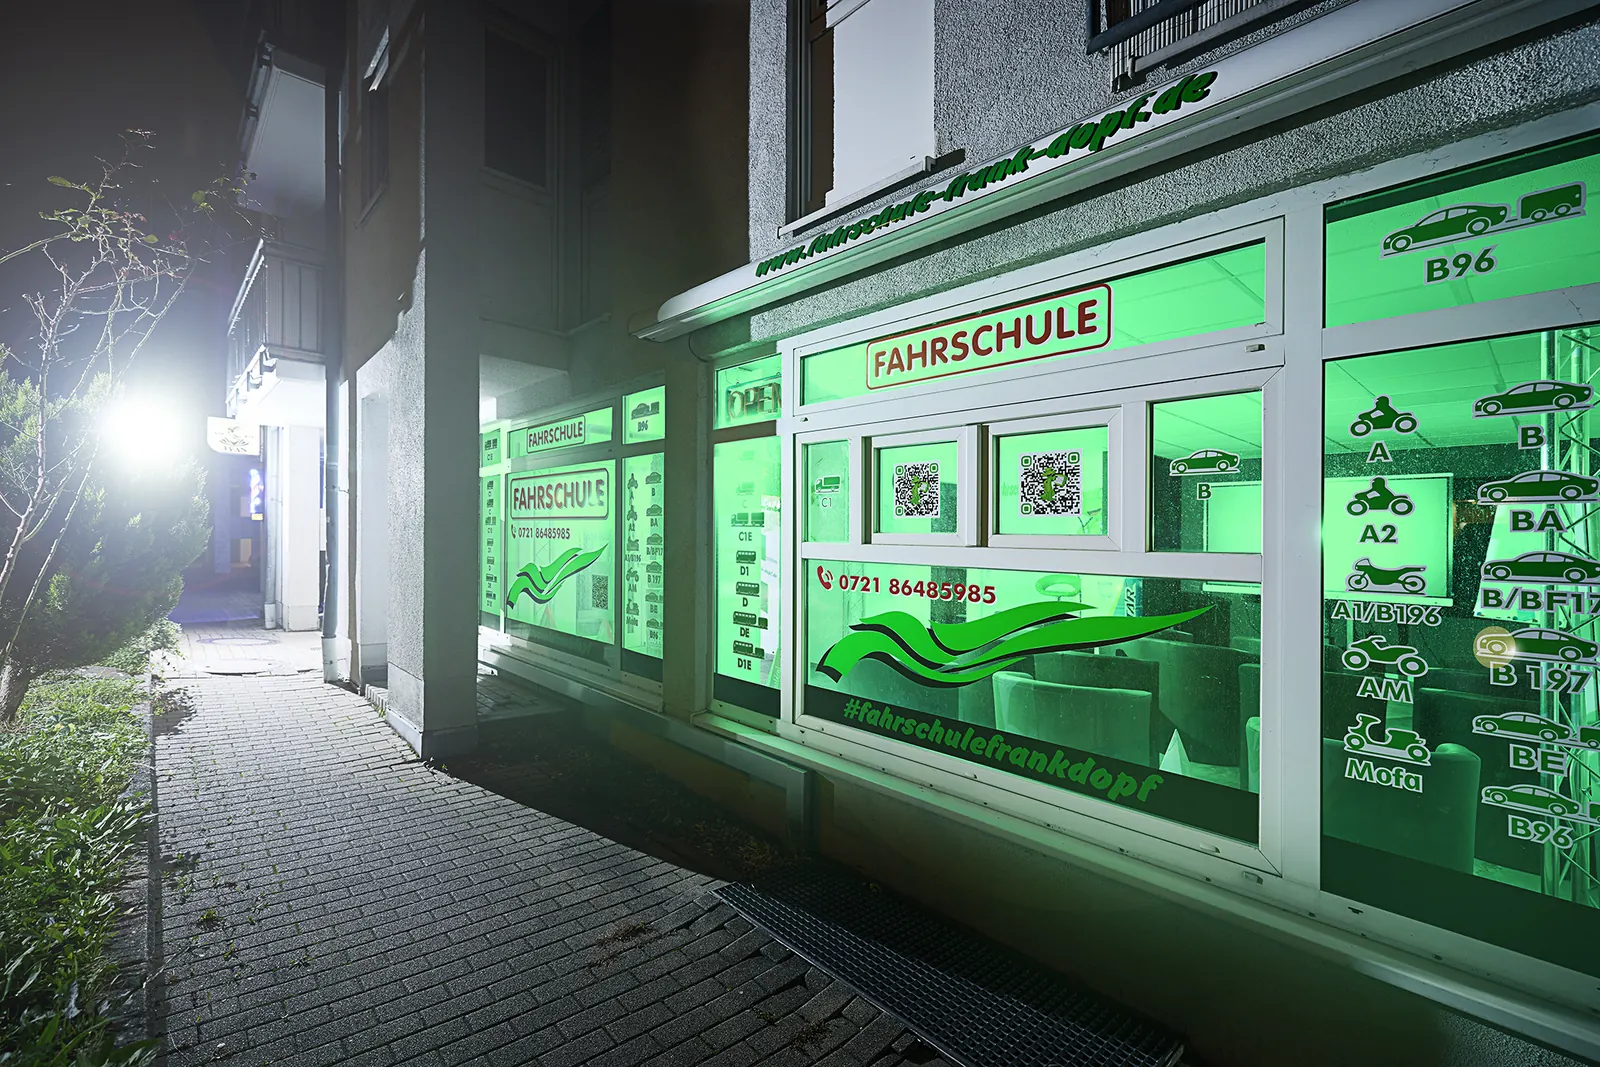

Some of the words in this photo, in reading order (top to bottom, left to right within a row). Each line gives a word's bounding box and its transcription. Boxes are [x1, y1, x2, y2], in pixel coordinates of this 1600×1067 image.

[755, 70, 1218, 278] www.fahrschule-frank-dopf.de
[1425, 246, 1498, 284] B96
[874, 299, 1099, 378] FAHRSCHULE
[528, 421, 583, 448] FAHRSCHULE
[1518, 425, 1546, 450] B
[1366, 441, 1392, 463] A
[513, 479, 605, 511] FAHRSCHULE
[821, 497, 832, 508] C1
[1197, 483, 1212, 500] B
[650, 517, 658, 527] BA
[1510, 508, 1568, 532] BA
[518, 527, 533, 538] 0721
[535, 527, 571, 540] 86485985
[738, 531, 752, 542] C1E
[1359, 524, 1398, 544] A2
[739, 565, 749, 576] D1
[839, 574, 881, 594] 0721
[889, 578, 997, 604] 86485985
[1483, 587, 1600, 614] B/BF17
[742, 597, 749, 607] D
[1331, 601, 1442, 626] A1/B196
[739, 627, 750, 638] DE
[737, 657, 751, 671] D1E
[1357, 676, 1413, 704] AM
[1490, 661, 1517, 686] B
[1527, 664, 1592, 694] 197
[844, 699, 1164, 802] #fahrschulefrankdopf
[1510, 743, 1568, 777] BE
[1345, 757, 1423, 793] Mofa
[1508, 815, 1574, 849] B96
